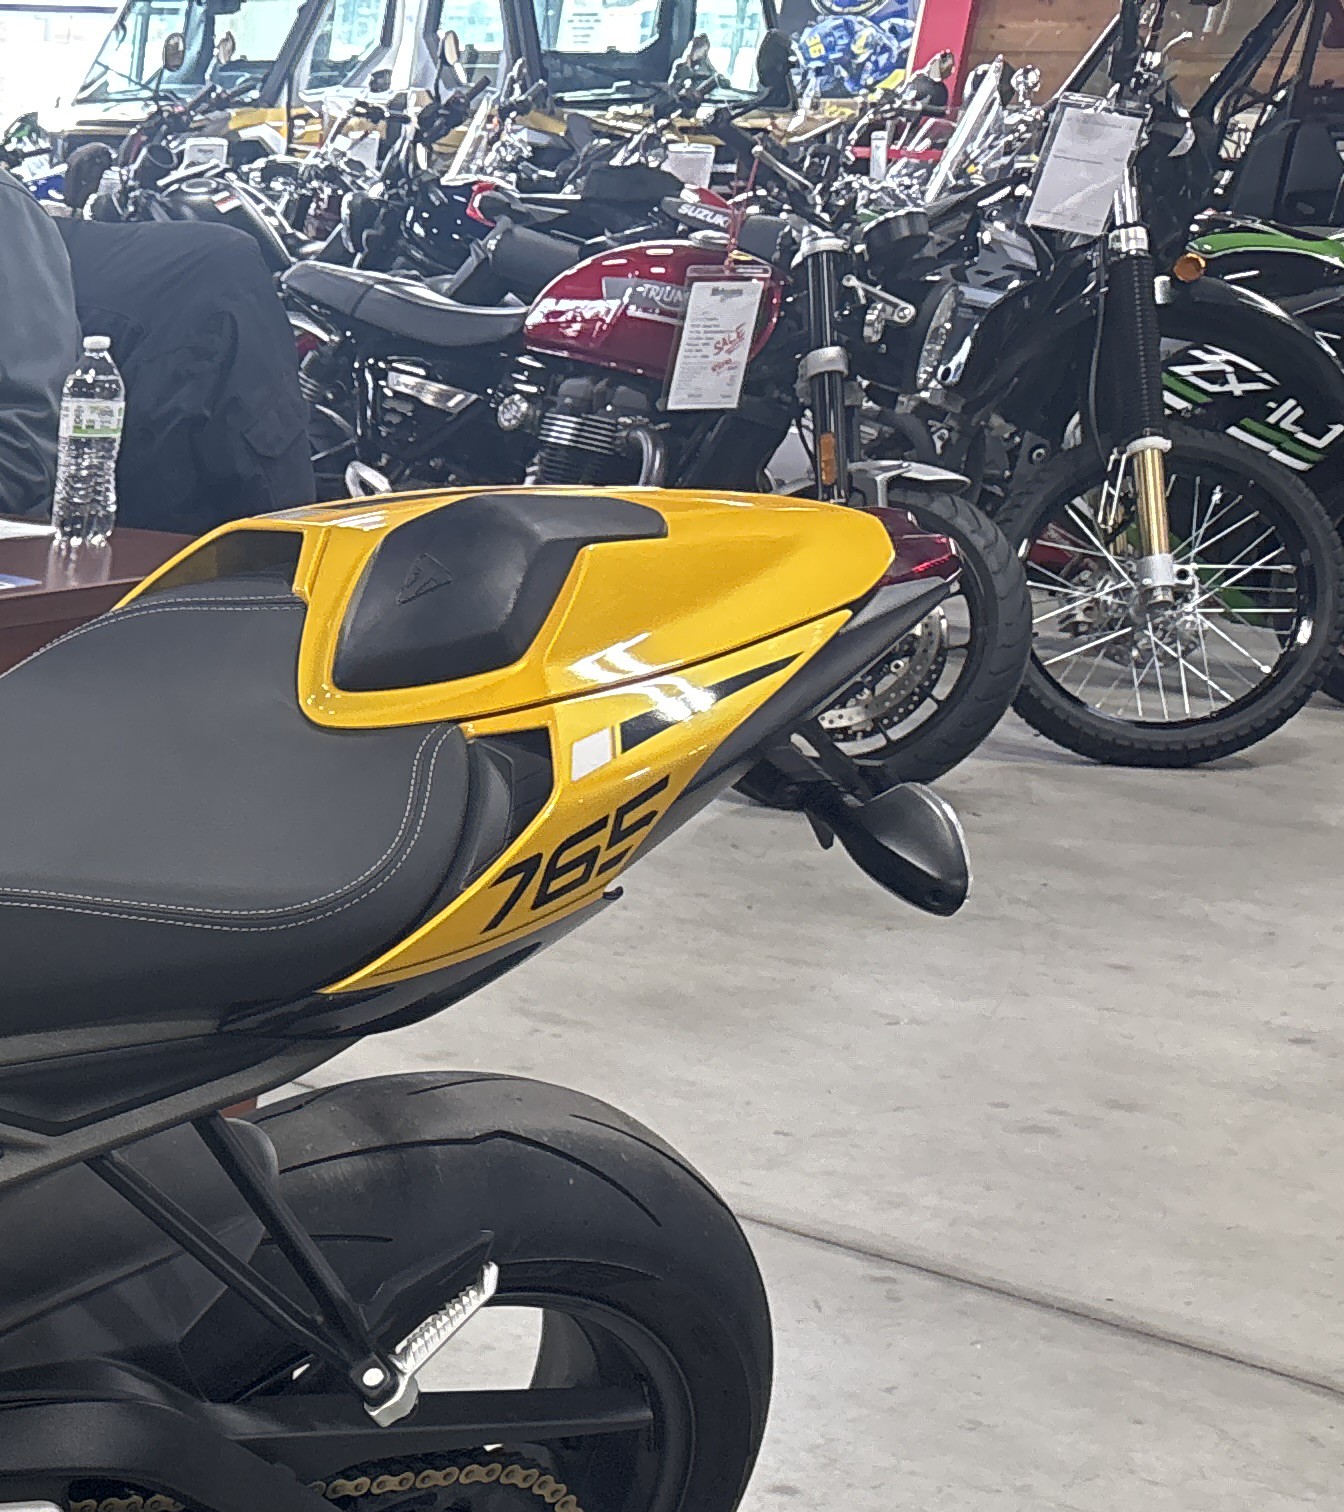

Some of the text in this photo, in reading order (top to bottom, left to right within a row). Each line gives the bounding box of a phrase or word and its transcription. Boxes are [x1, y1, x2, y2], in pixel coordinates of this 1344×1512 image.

[678, 203, 730, 228] SUZUK
[637, 283, 686, 304] TRIUM
[479, 774, 671, 935] 765
